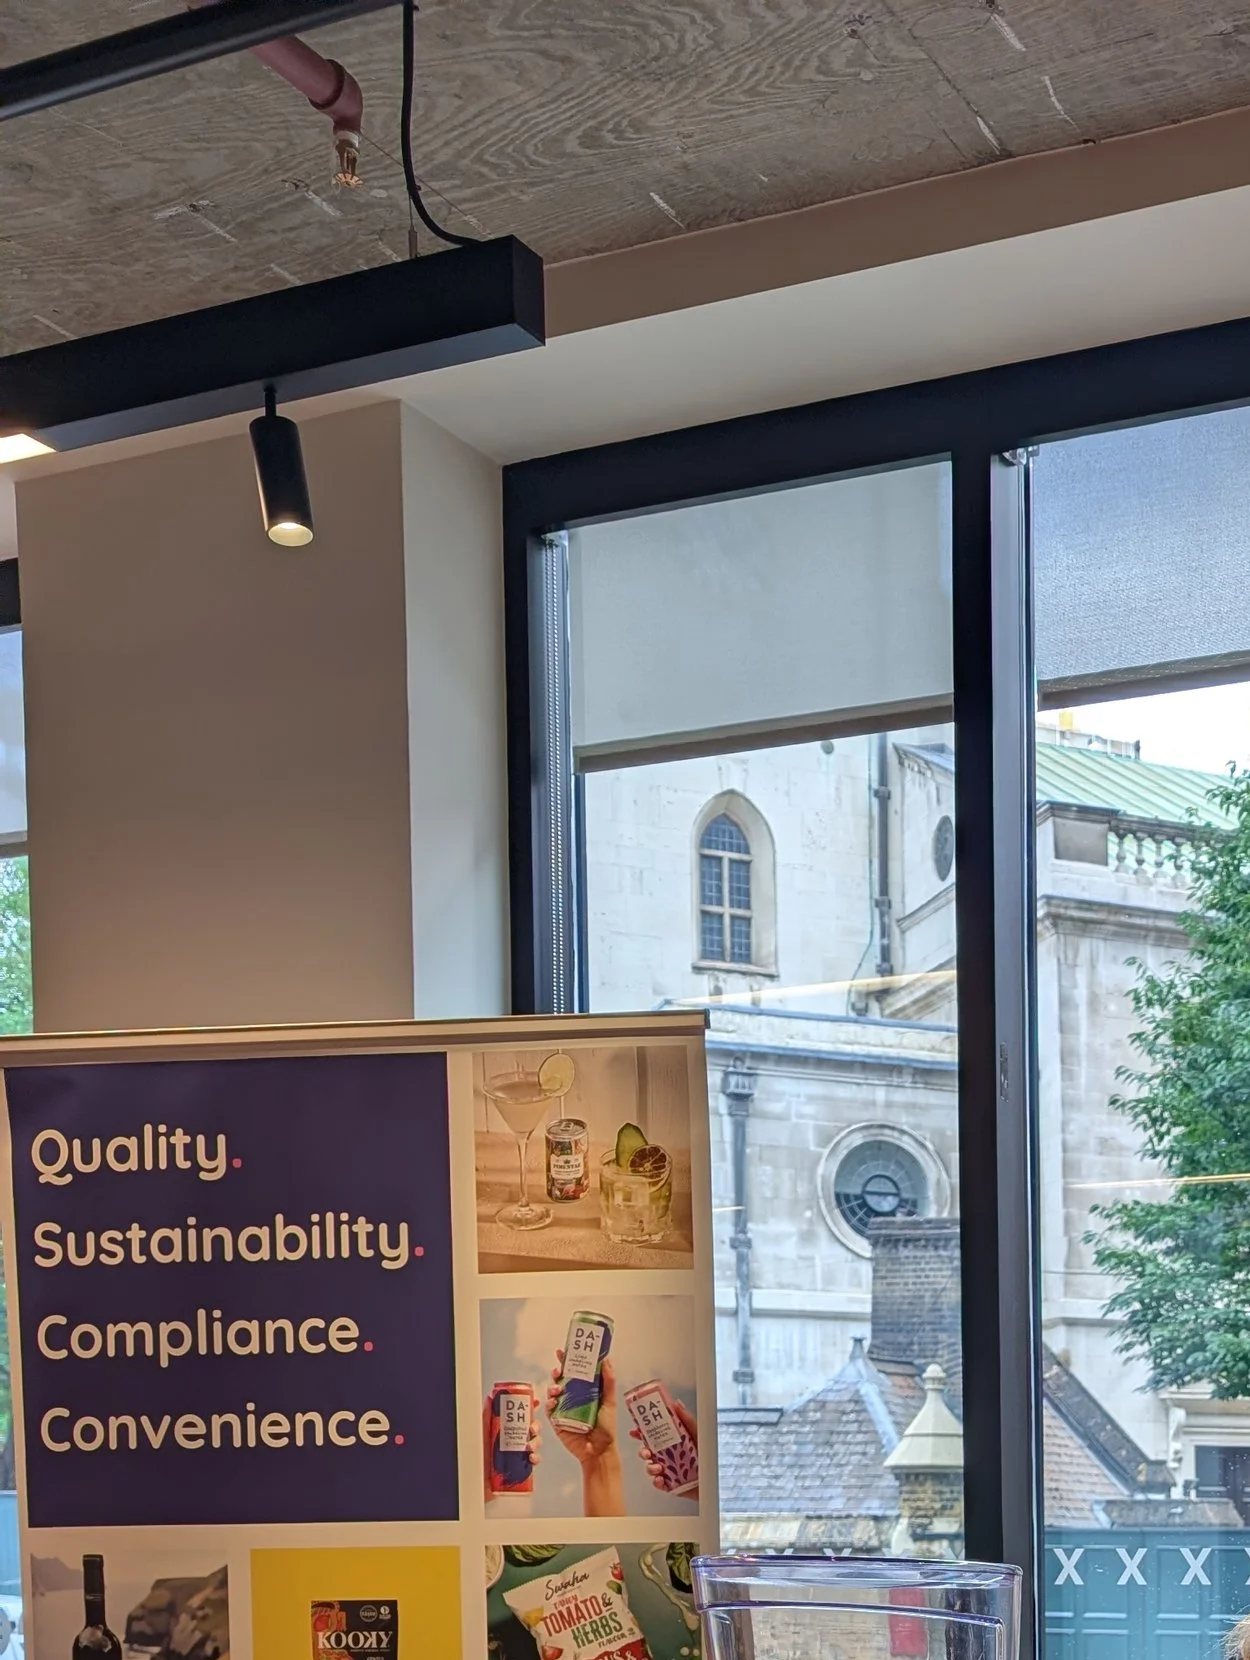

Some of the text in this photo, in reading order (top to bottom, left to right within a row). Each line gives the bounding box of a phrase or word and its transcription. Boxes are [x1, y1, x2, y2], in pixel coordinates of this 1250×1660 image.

[31, 1123, 242, 1186] Quality.
[33, 1211, 425, 1270] Sustainability.
[37, 1308, 374, 1368] Compliance.
[40, 1402, 404, 1452] Convenience.
[541, 1592, 614, 1637] TOMATO &
[571, 1611, 624, 1649] HERBS
